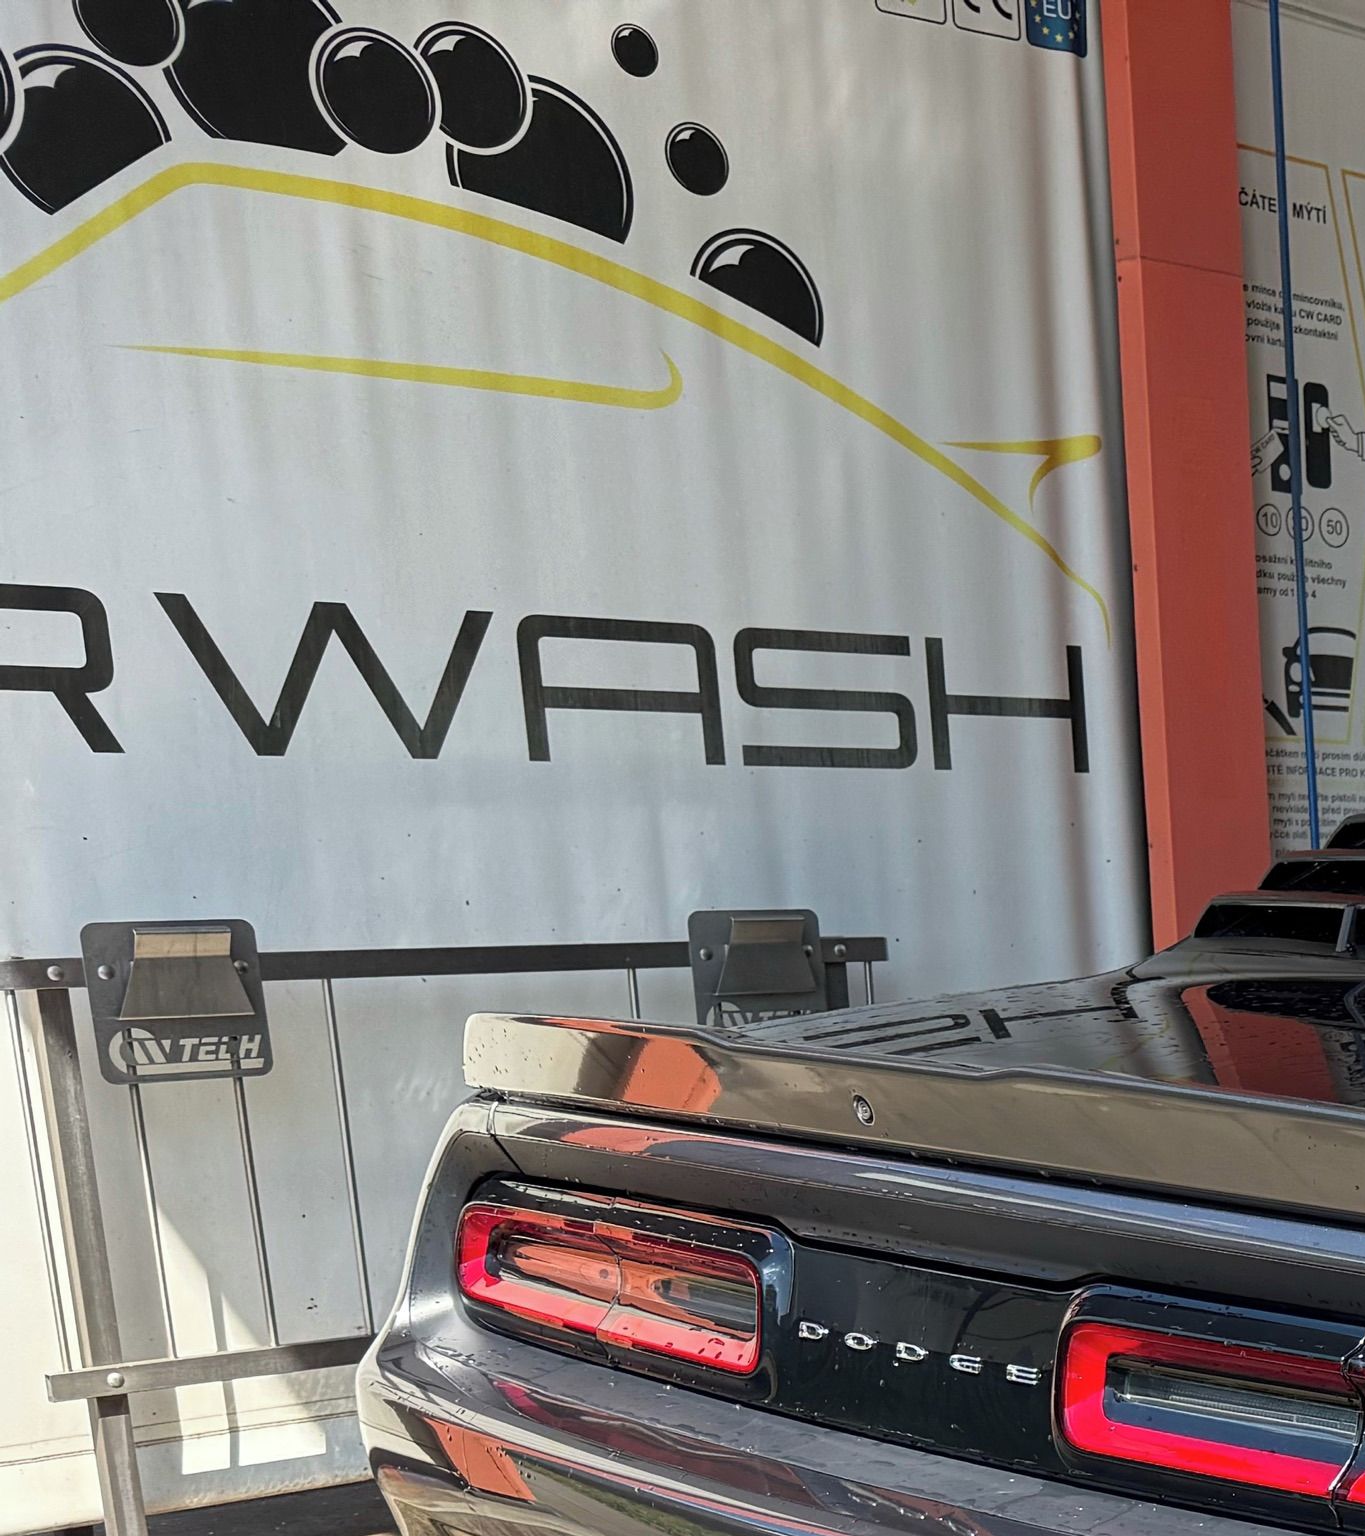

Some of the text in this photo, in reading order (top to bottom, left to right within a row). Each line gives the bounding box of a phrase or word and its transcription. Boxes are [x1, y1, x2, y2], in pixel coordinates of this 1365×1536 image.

[1238, 187, 1277, 213] ČÁTE
[1262, 512, 1279, 530] 10
[1326, 519, 1343, 537] 50
[1338, 767, 1358, 778] PRO
[179, 1034, 262, 1062] TECH
[798, 1321, 1042, 1385] DODGE
